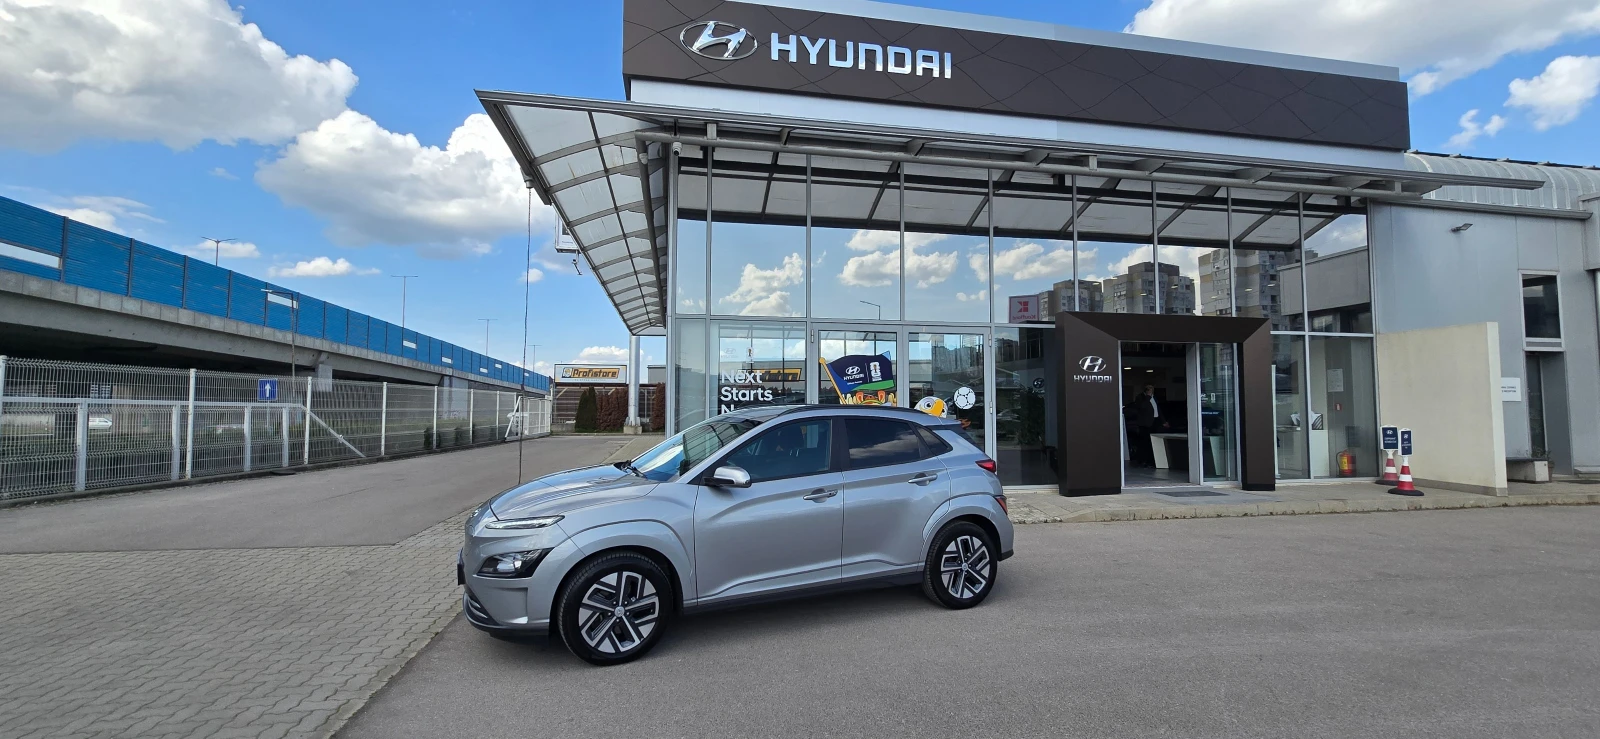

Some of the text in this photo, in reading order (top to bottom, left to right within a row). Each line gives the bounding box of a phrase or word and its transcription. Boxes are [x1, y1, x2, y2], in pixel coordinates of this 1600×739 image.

[770, 32, 952, 79] HYUNDAI
[572, 368, 617, 378] Profistore
[721, 369, 763, 384] Next
[843, 373, 865, 381] HYUNDAI
[1073, 374, 1113, 383] HYUNDAI
[720, 386, 773, 401] Starts
